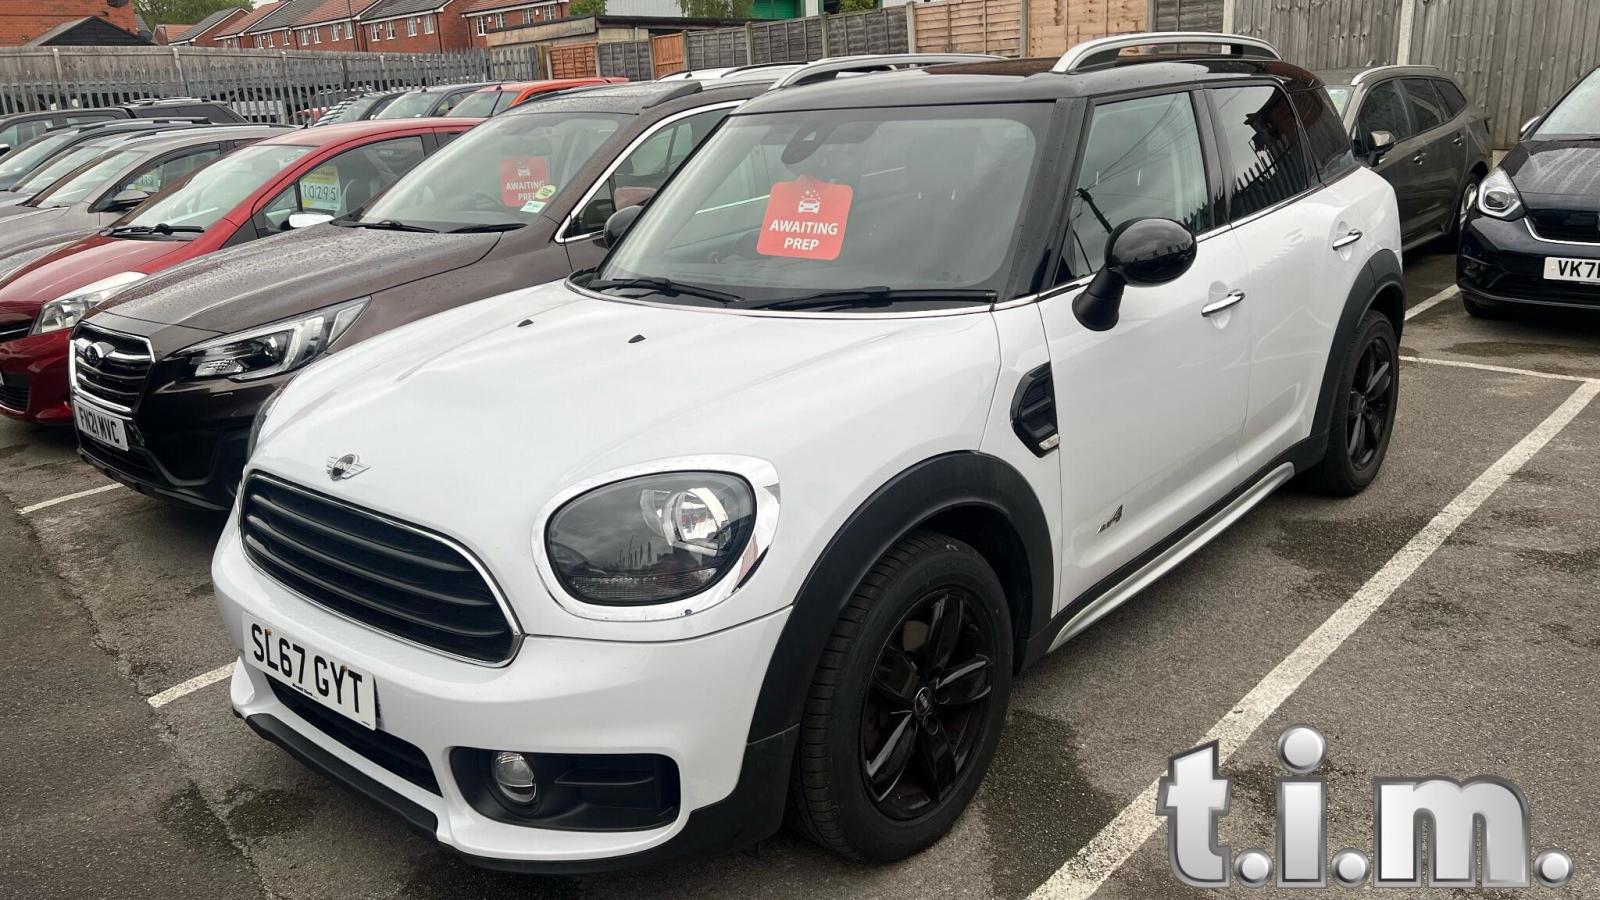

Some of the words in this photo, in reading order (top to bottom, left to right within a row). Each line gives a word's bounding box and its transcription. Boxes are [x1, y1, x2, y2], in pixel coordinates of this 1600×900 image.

[505, 180, 545, 191] AWAITING
[769, 219, 839, 235] AWAITING
[784, 237, 819, 251] PREP
[97, 415, 120, 444] MVC
[251, 623, 306, 685] SL67
[313, 654, 363, 714] GYT
